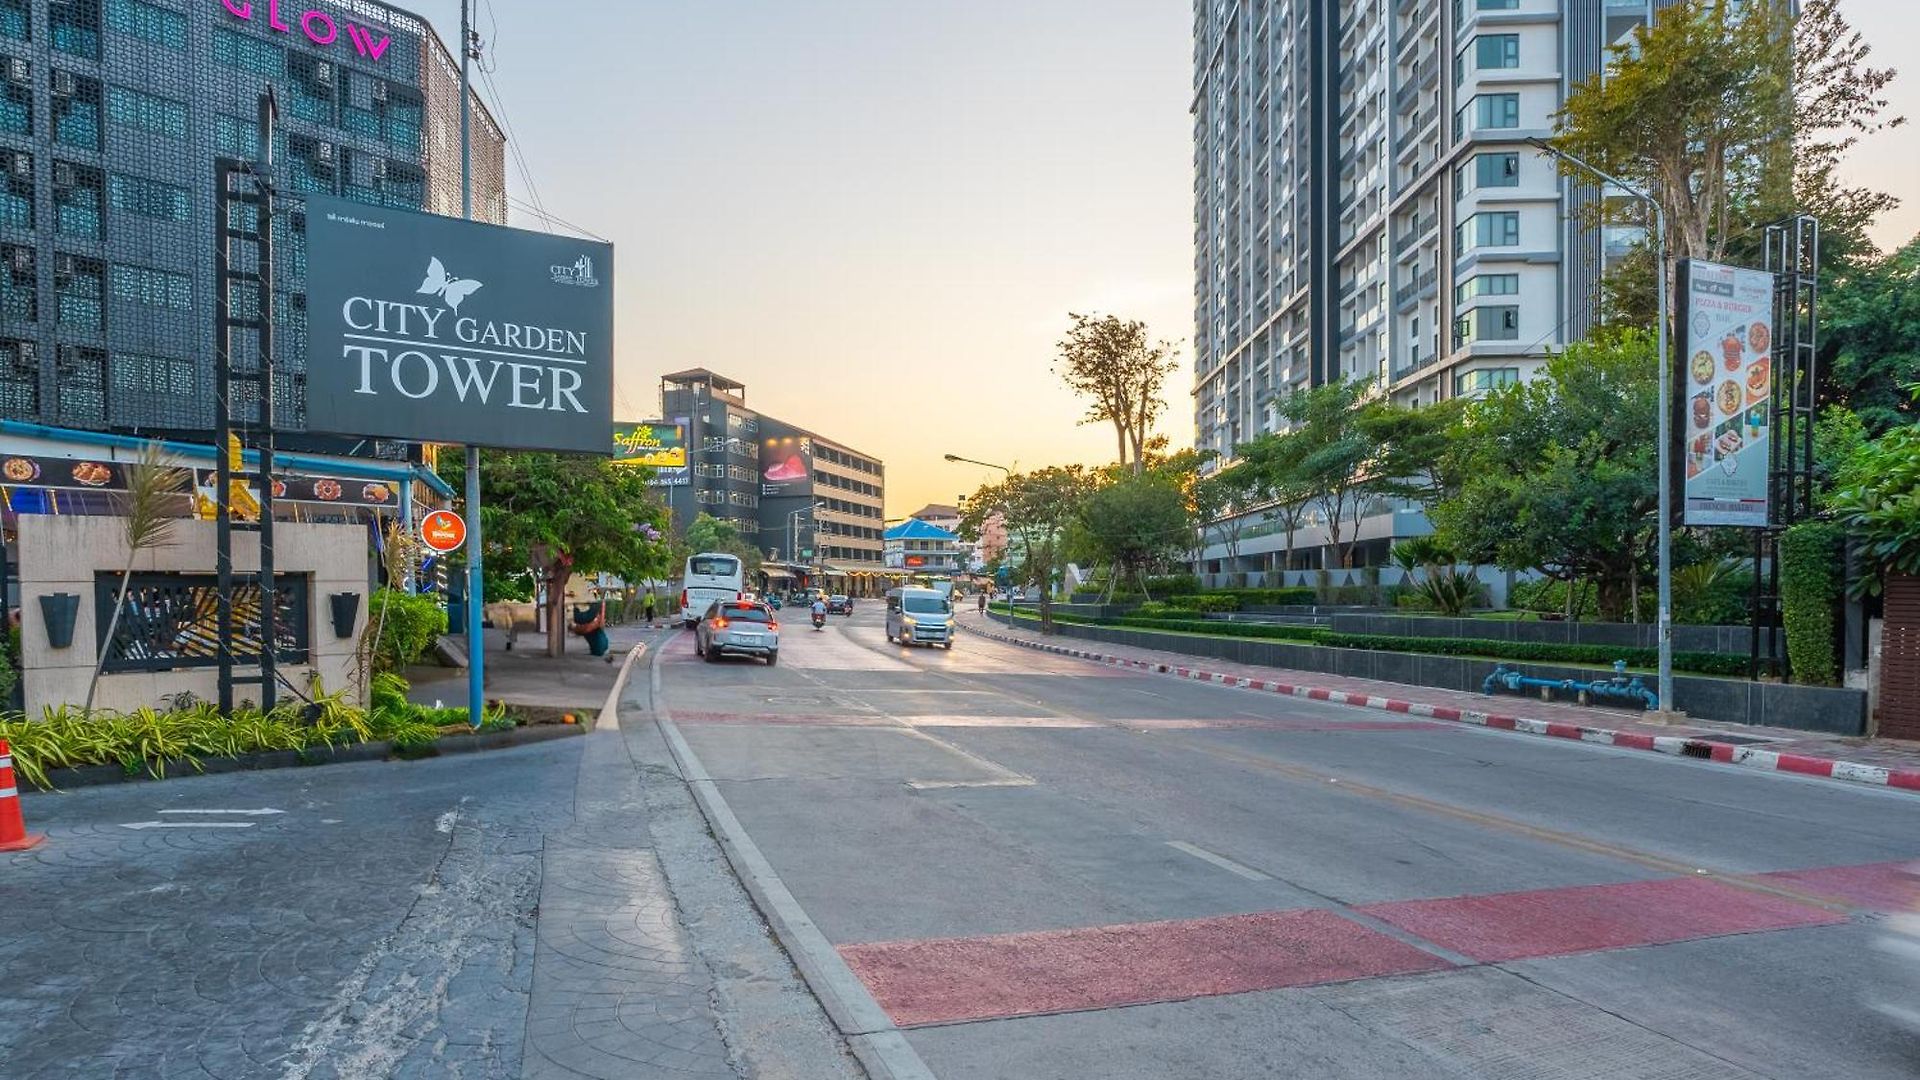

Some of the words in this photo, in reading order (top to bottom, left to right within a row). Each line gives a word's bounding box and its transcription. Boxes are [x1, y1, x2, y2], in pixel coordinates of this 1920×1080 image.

[342, 296, 446, 339] CITY
[455, 317, 588, 356] GARDEN
[343, 344, 589, 413] TOWER
[613, 431, 660, 454] Saffron
